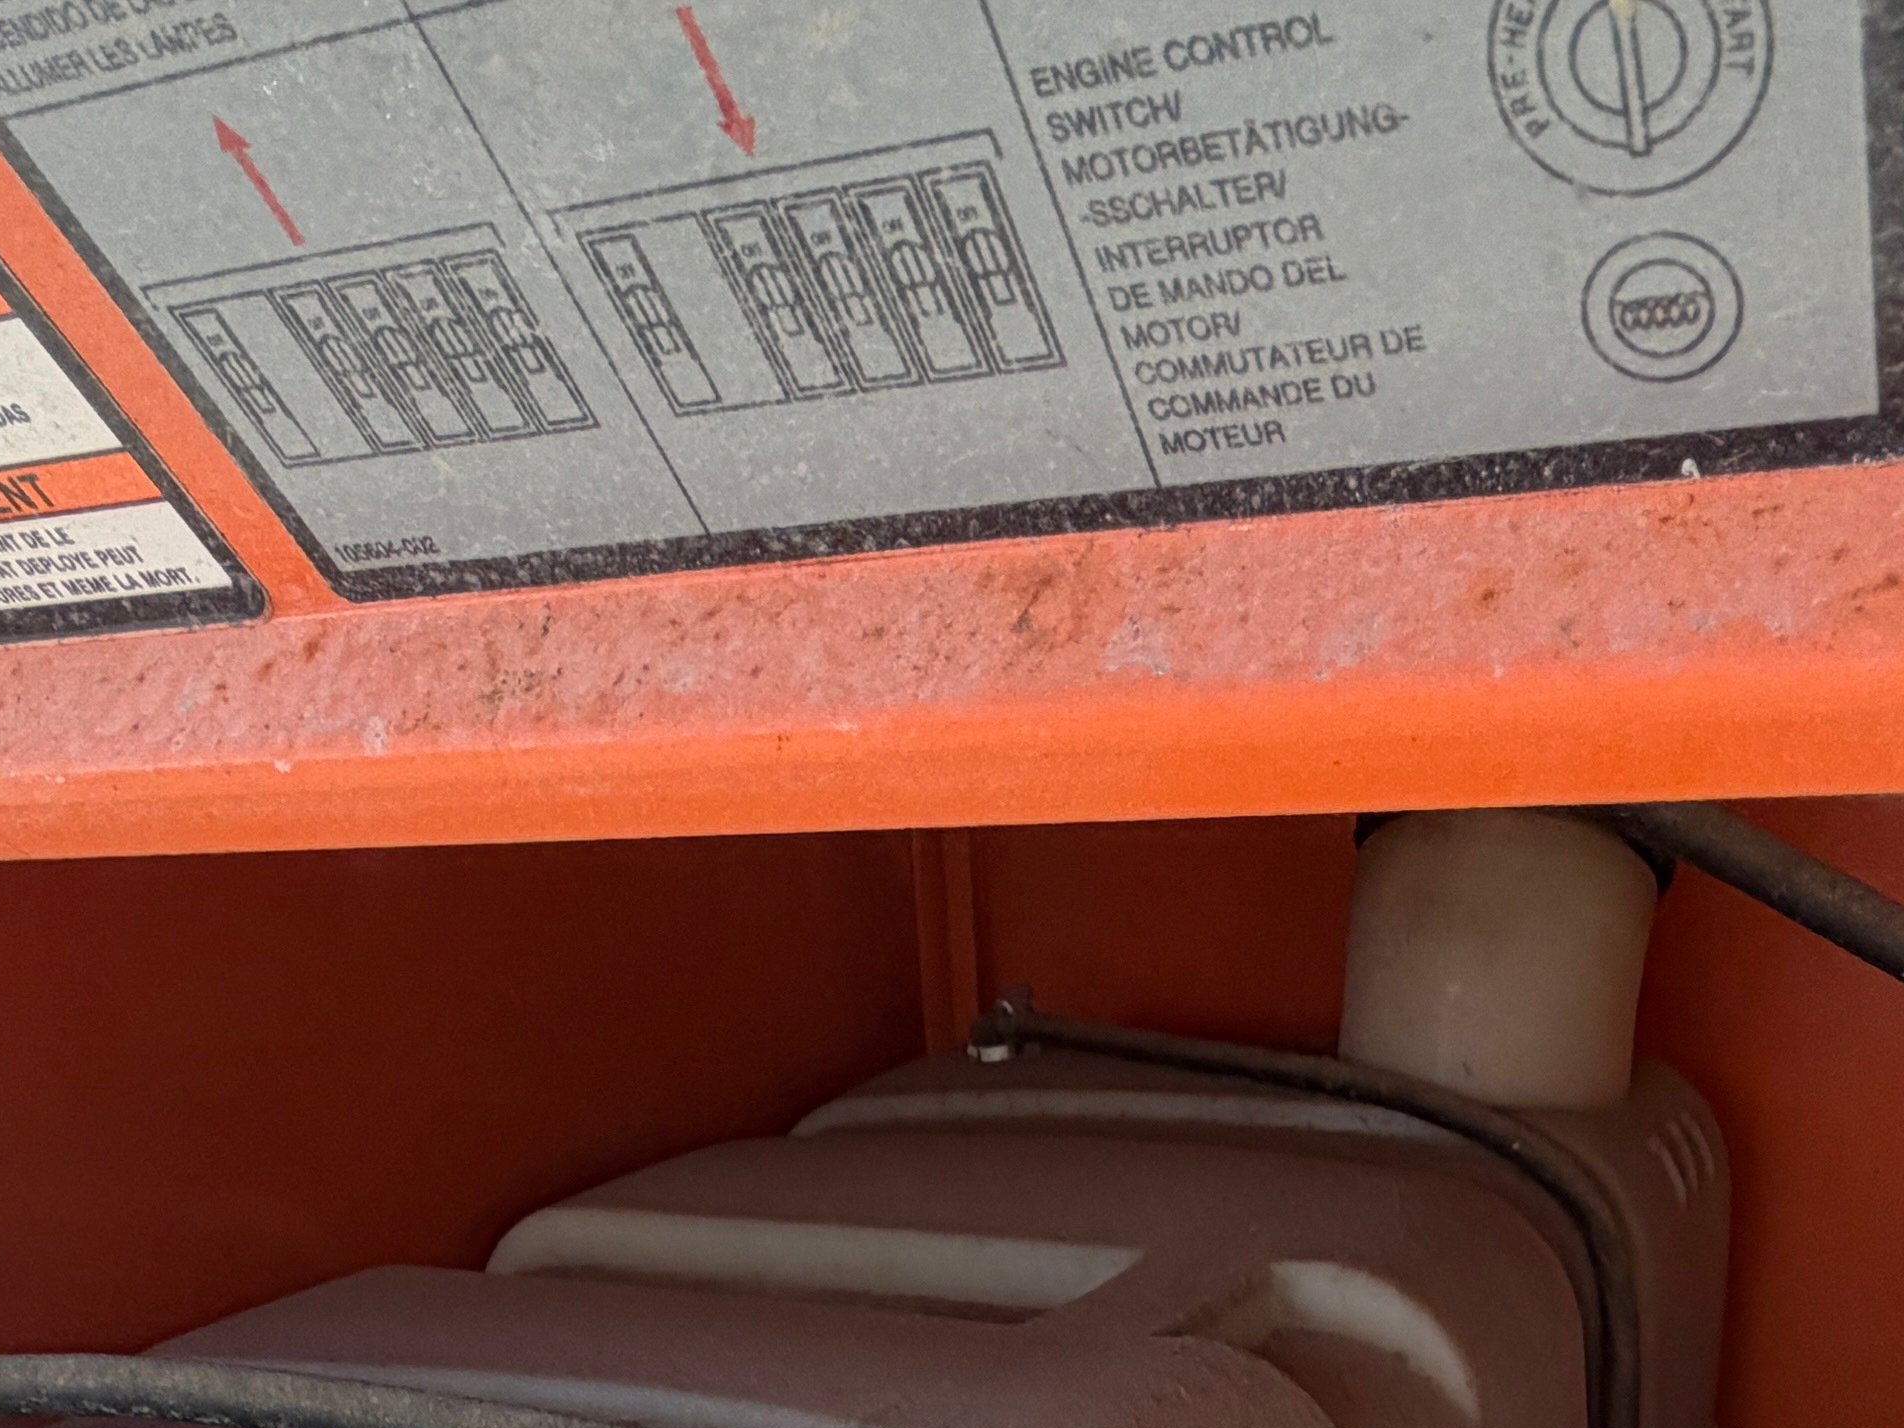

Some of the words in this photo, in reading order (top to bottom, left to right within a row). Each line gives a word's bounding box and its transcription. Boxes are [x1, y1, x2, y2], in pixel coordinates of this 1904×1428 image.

[88, 37, 138, 72] LES
[1030, 46, 1157, 98] ENGINE
[1163, 12, 1335, 72] CONTROL
[1046, 89, 1183, 144] SWITCH/
[1061, 102, 1412, 189] MOTORBETÄTIGUNG-
[1096, 212, 1326, 274] INTERRUPTOR
[1107, 285, 1154, 312] DE
[1156, 264, 1275, 305] MANDO
[1281, 255, 1349, 288] DEL
[1120, 310, 1243, 350] MOTOR/
[1134, 331, 1375, 386] COMMUTATEUR
[1379, 323, 1428, 357] DE
[1147, 376, 1326, 422] COMMANDE
[1330, 371, 1378, 400] DU
[1159, 418, 1288, 457] MOTEUR
[18, 530, 47, 548] DE
[47, 527, 76, 546] LE
[93, 545, 145, 567] PEUT
[38, 581, 64, 598] ET
[112, 573, 143, 590] LA
[137, 567, 201, 587] MORT.
